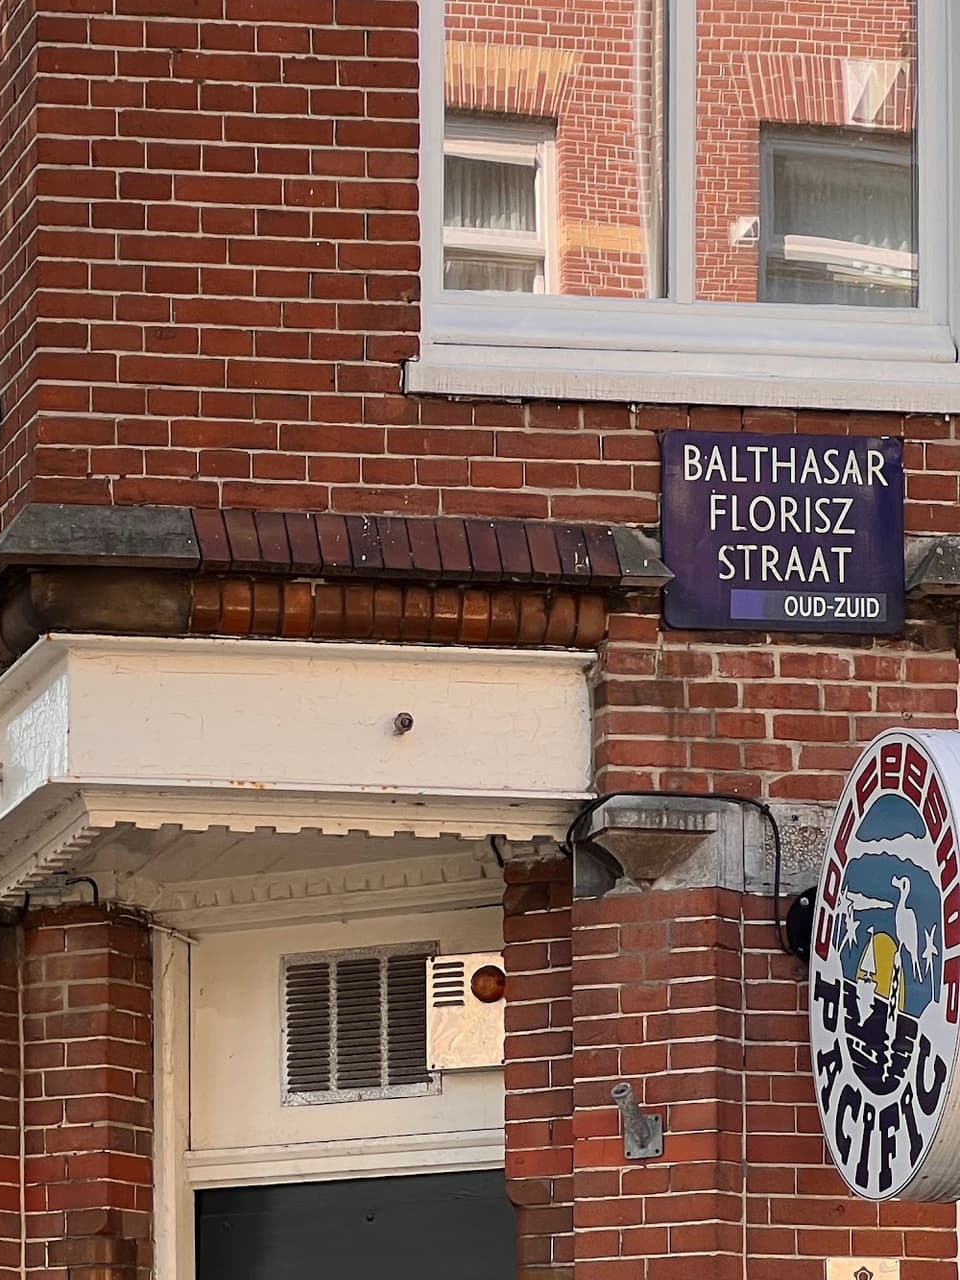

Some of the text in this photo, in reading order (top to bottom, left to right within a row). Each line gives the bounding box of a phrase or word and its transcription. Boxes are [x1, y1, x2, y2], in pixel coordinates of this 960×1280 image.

[683, 444, 888, 487] BALTHASAR
[710, 494, 856, 535] FLORISZ
[718, 544, 852, 583] STRAAT
[784, 596, 880, 619] OUD-ZUID
[814, 970, 946, 1193] PACIFIC
